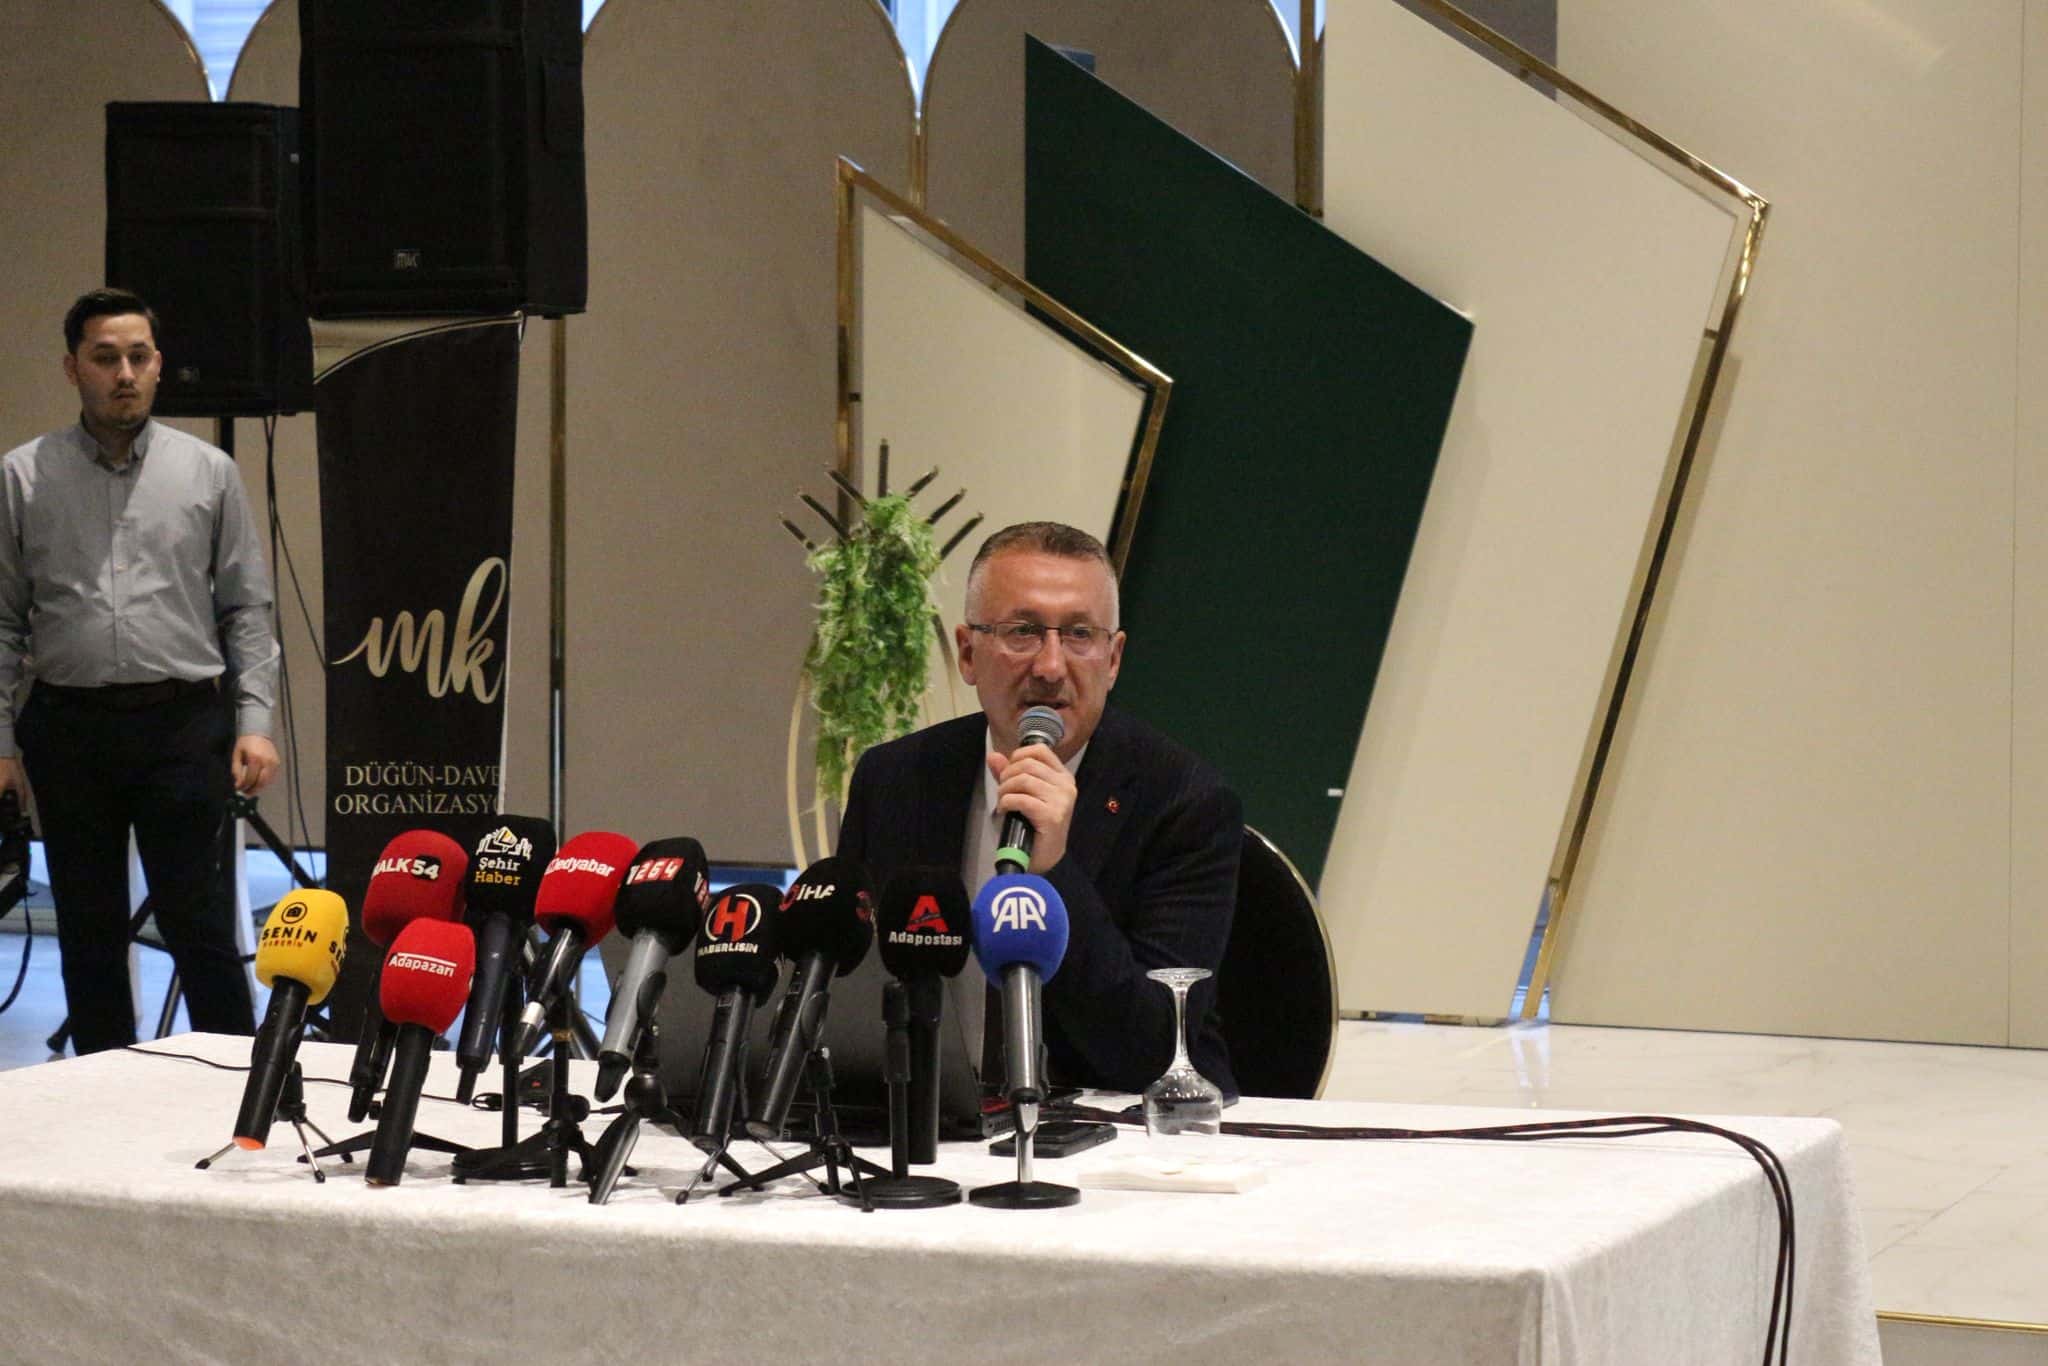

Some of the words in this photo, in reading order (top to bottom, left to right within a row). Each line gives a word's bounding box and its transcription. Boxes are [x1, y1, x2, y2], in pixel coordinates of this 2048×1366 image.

[479, 856, 520, 871] Şehir
[475, 871, 520, 885] Haber
[992, 896, 1047, 933] AA
